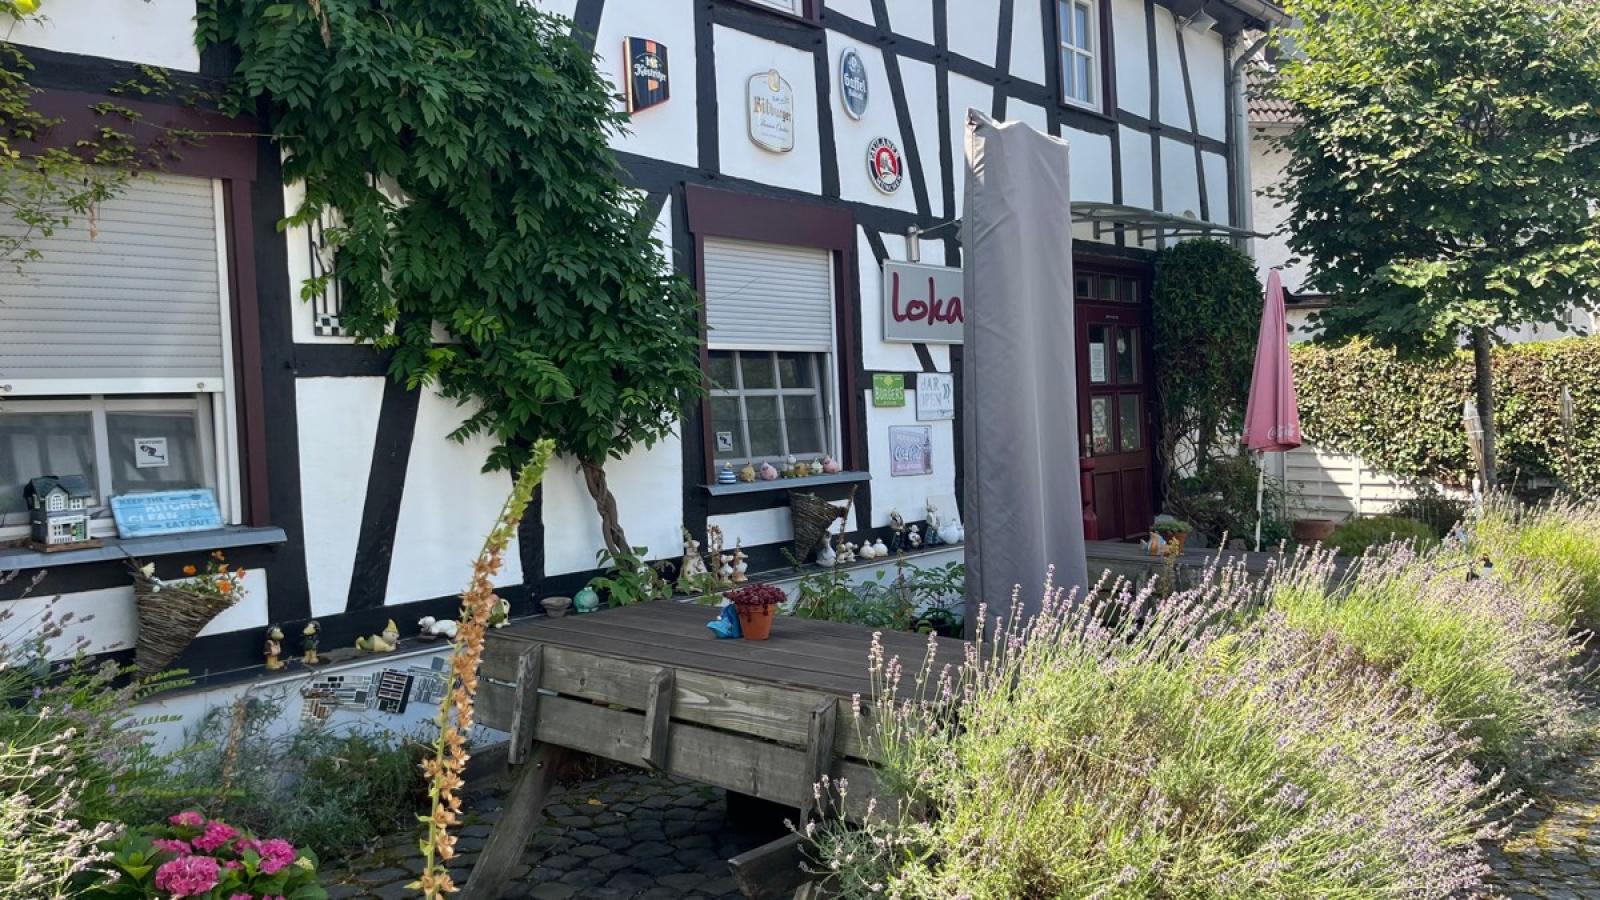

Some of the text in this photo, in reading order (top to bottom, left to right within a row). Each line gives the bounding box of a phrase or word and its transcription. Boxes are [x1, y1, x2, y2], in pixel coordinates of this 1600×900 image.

[892, 271, 964, 326] Loka
[874, 386, 904, 401] BURGERS
[144, 500, 210, 514] KITCHEN
[128, 512, 179, 523] CLEAN
[166, 518, 210, 529] EAT OUT
